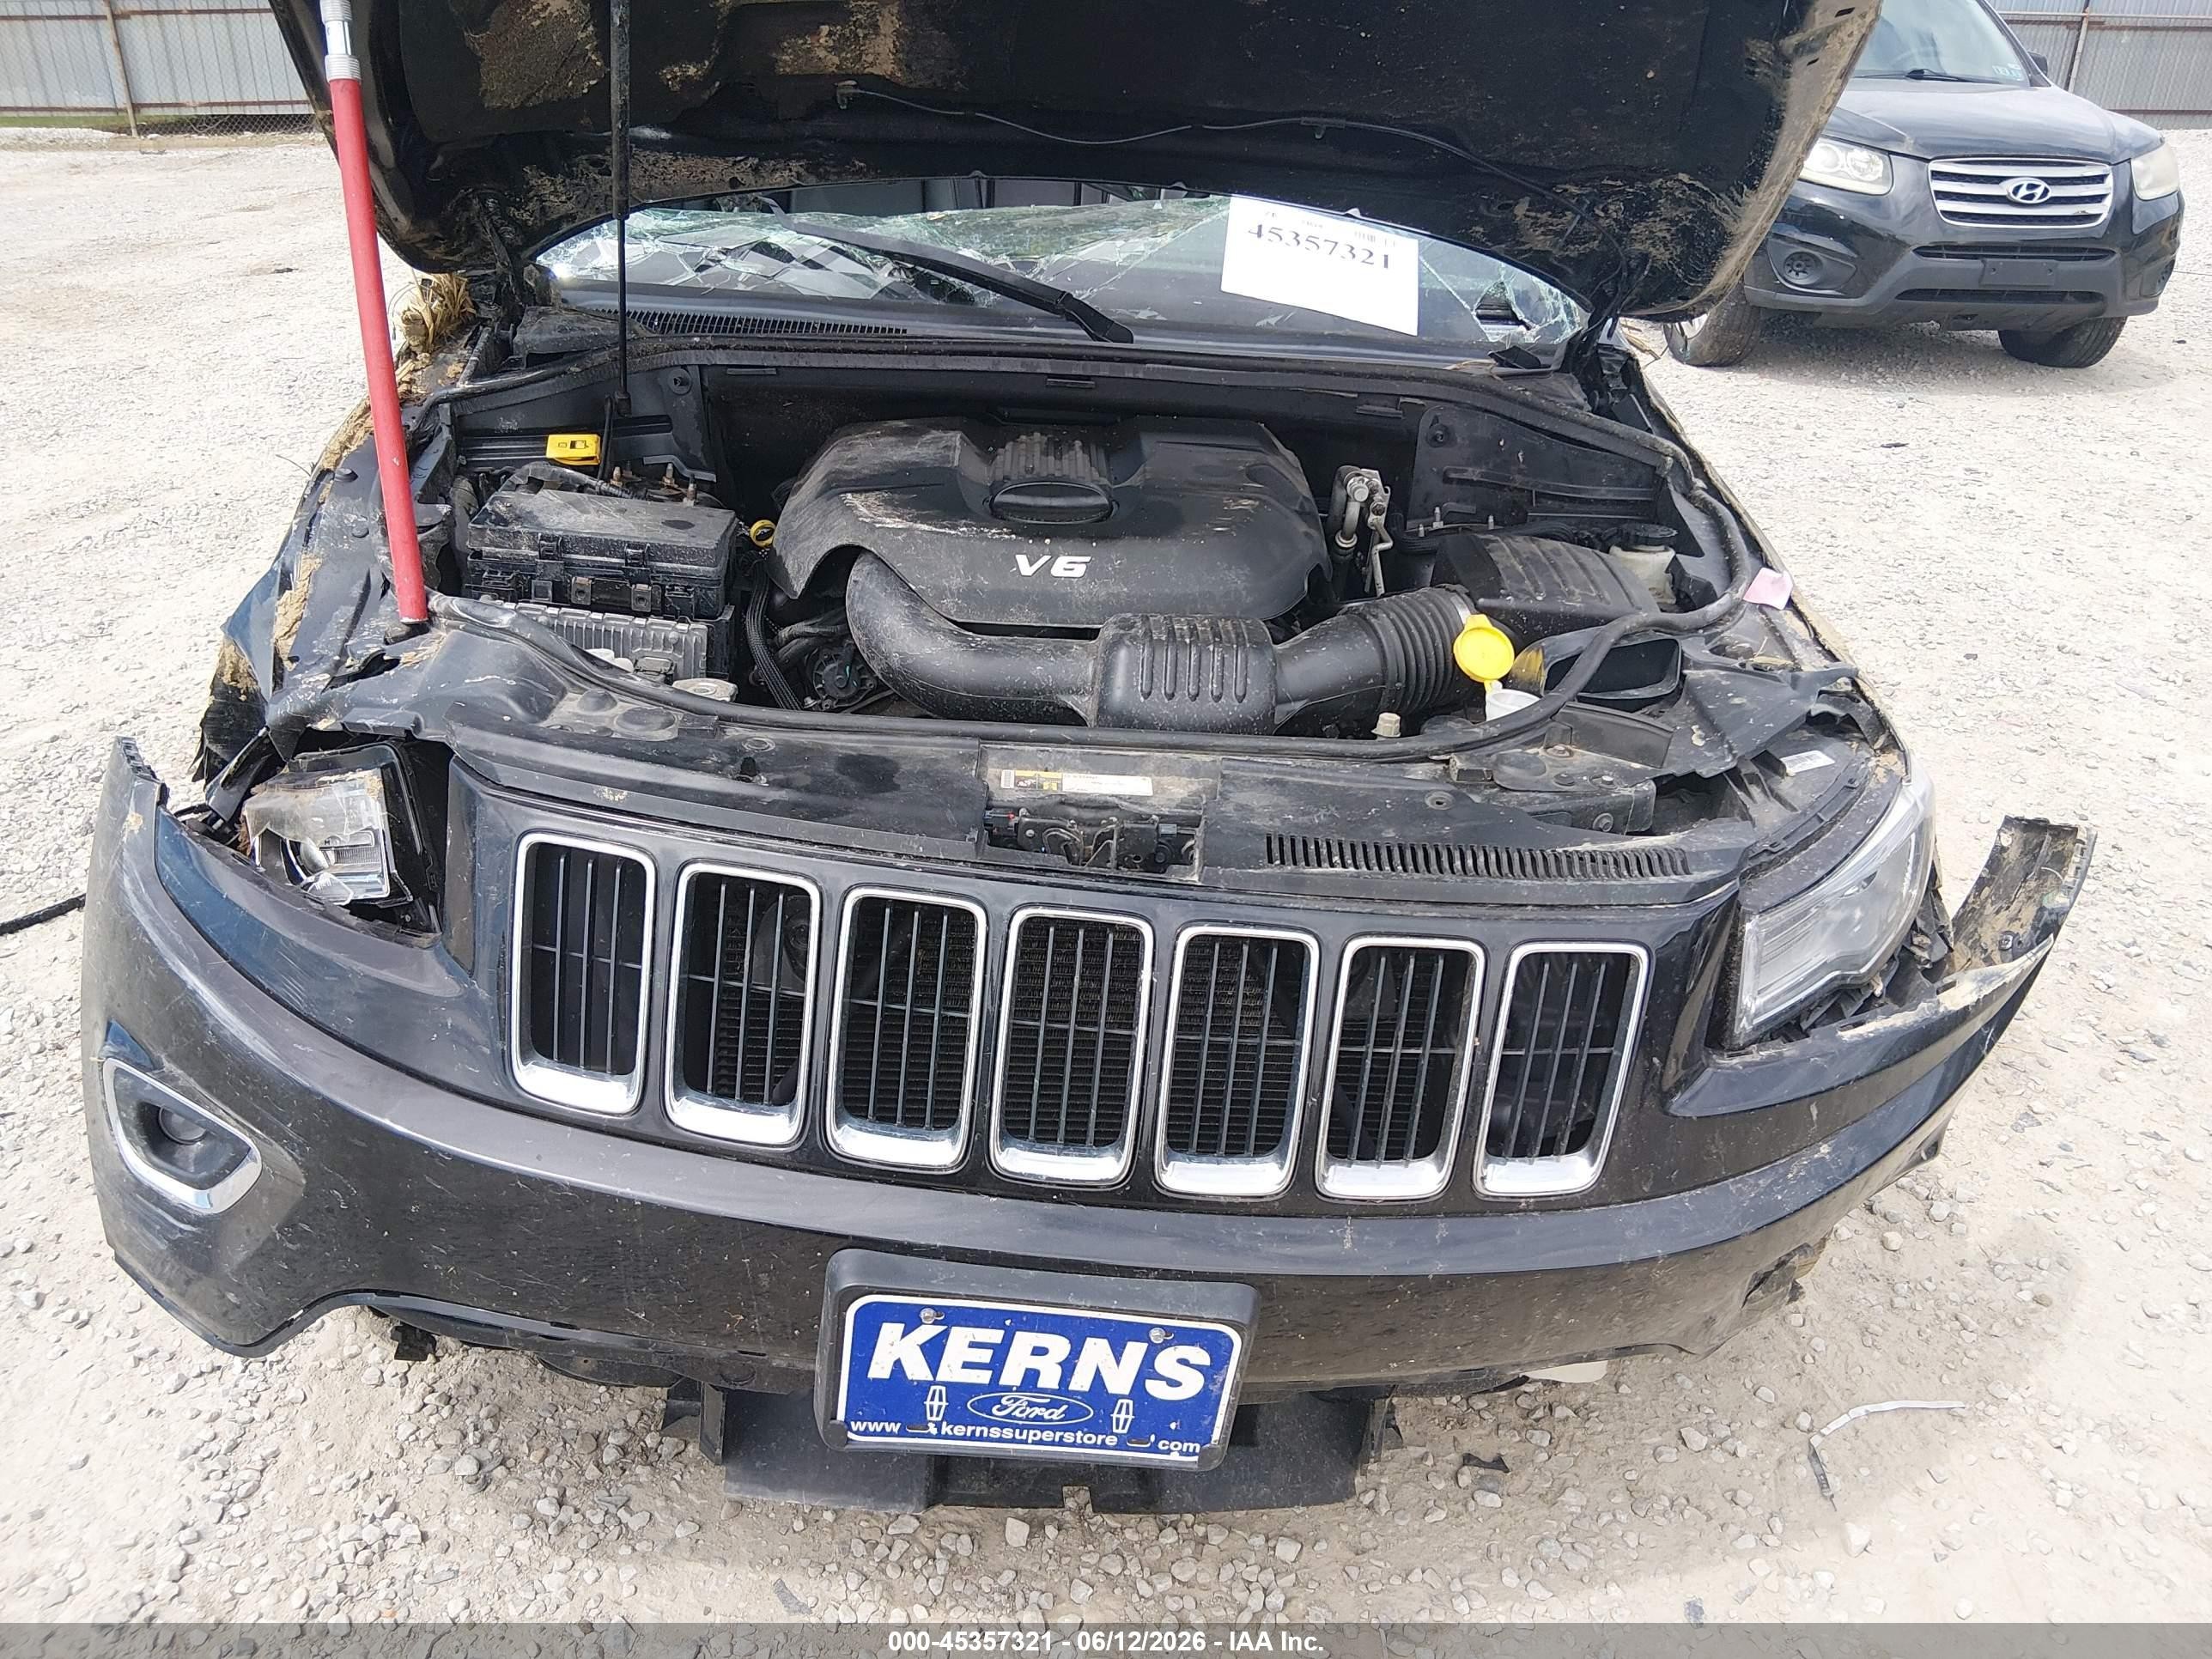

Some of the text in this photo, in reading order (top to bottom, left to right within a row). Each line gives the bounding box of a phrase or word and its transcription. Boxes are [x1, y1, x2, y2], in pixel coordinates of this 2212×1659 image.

[1248, 223, 1389, 270] 45357321
[1014, 554, 1092, 578] V6
[866, 1322, 1212, 1401] KERNS
[991, 1395, 1069, 1421] Ford
[940, 1421, 1119, 1446] kernssuperstore
[1158, 1438, 1200, 1454] com
